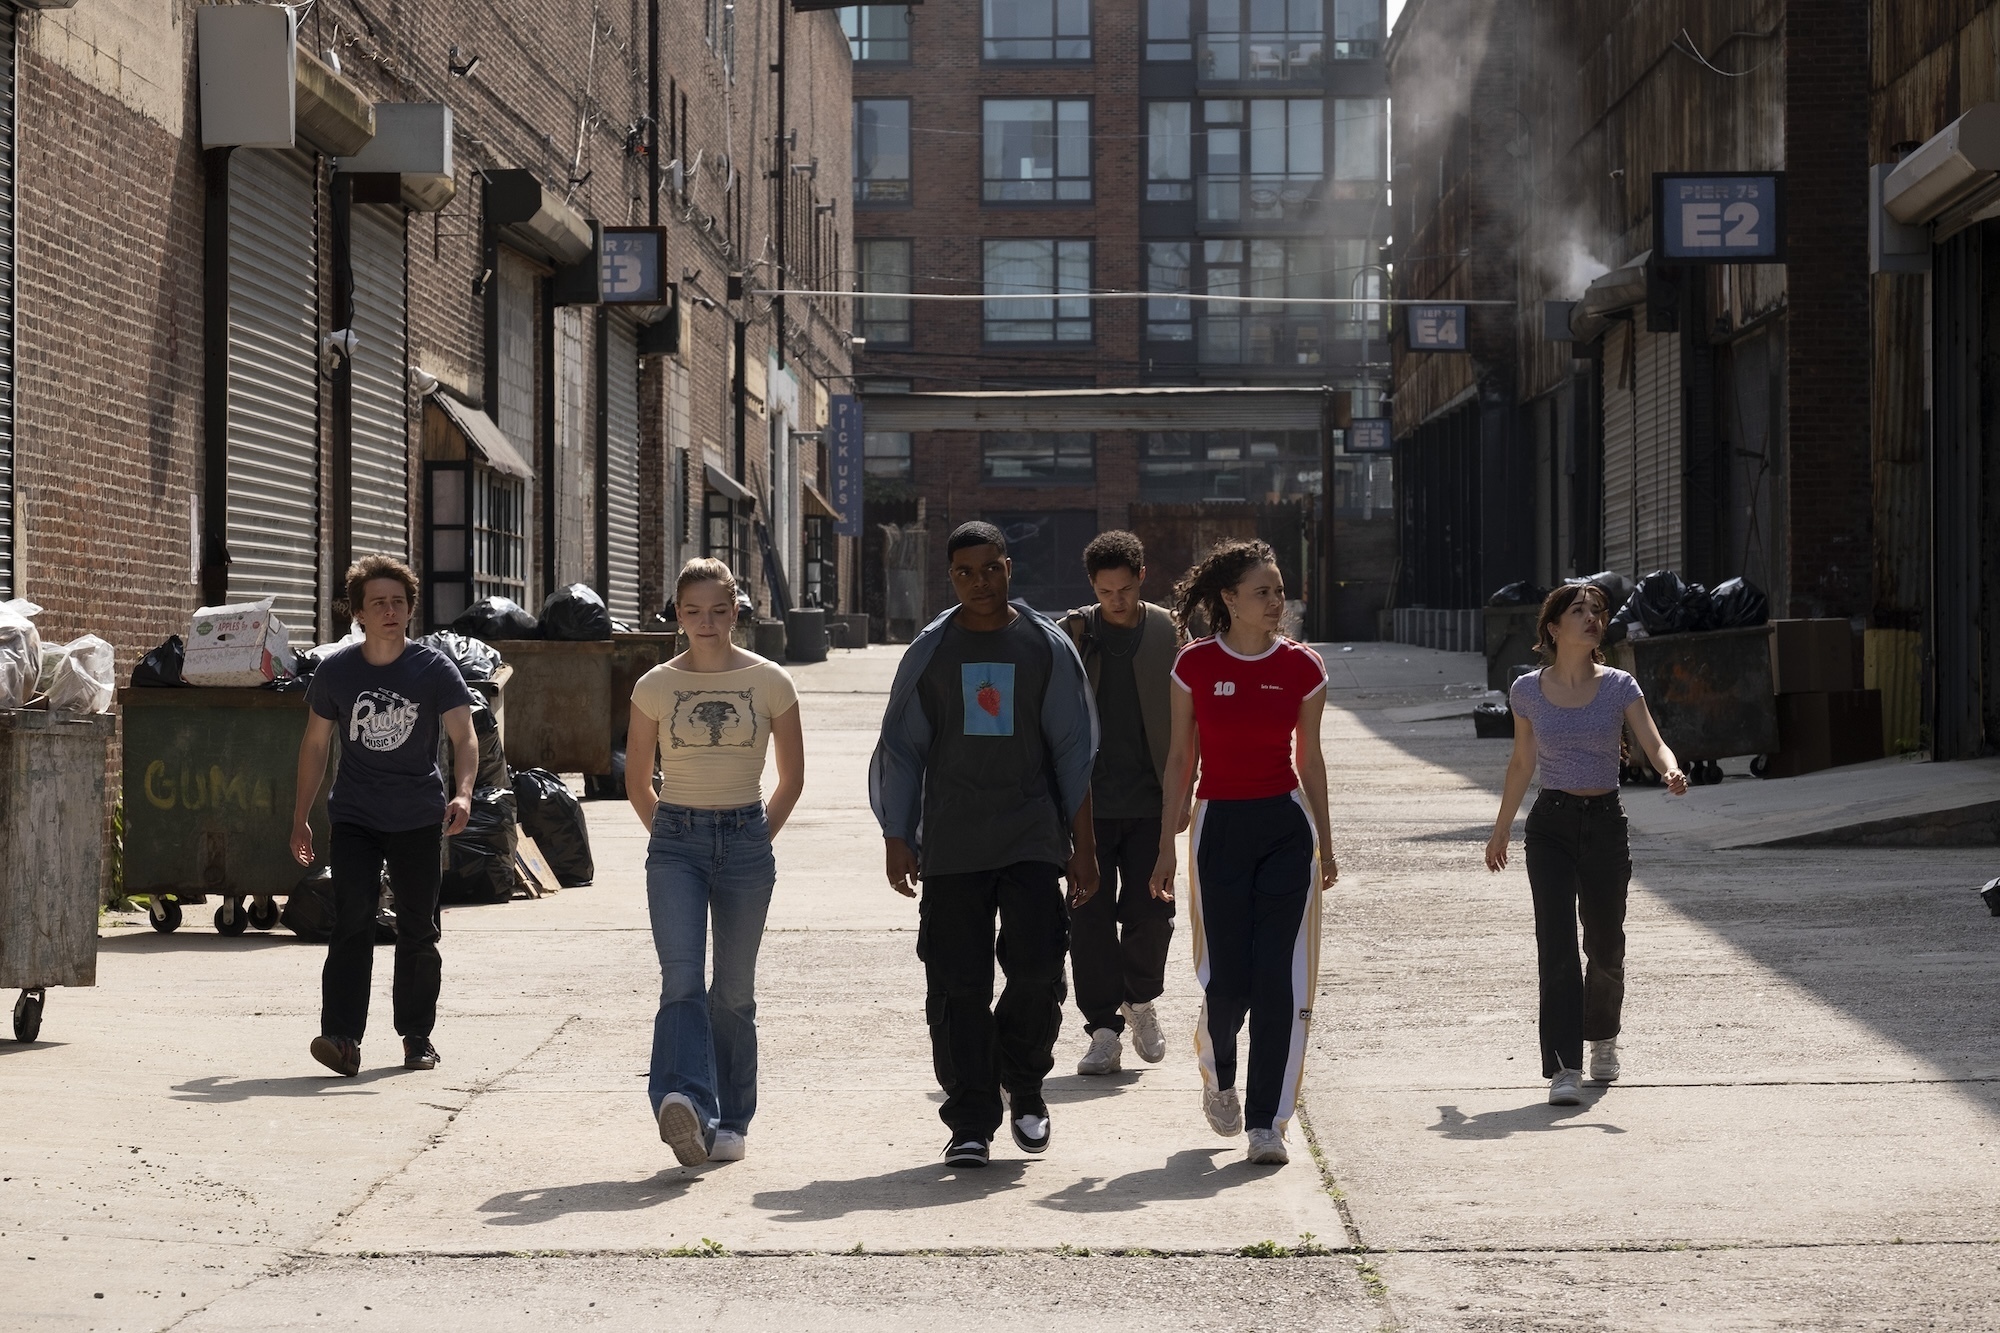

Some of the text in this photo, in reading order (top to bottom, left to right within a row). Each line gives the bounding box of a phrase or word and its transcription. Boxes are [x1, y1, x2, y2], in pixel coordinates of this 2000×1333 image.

[1680, 184, 1759, 199] PIER 75
[1682, 202, 1760, 248] E2
[623, 240, 643, 252] 75
[602, 255, 642, 293] 3
[1416, 319, 1458, 344] E4
[838, 403, 849, 457] PICK
[1353, 429, 1385, 448] E5
[838, 464, 849, 505] UPS
[216, 621, 241, 633] APPLES
[1213, 681, 1236, 696] 10
[364, 735, 389, 748] MUSIC
